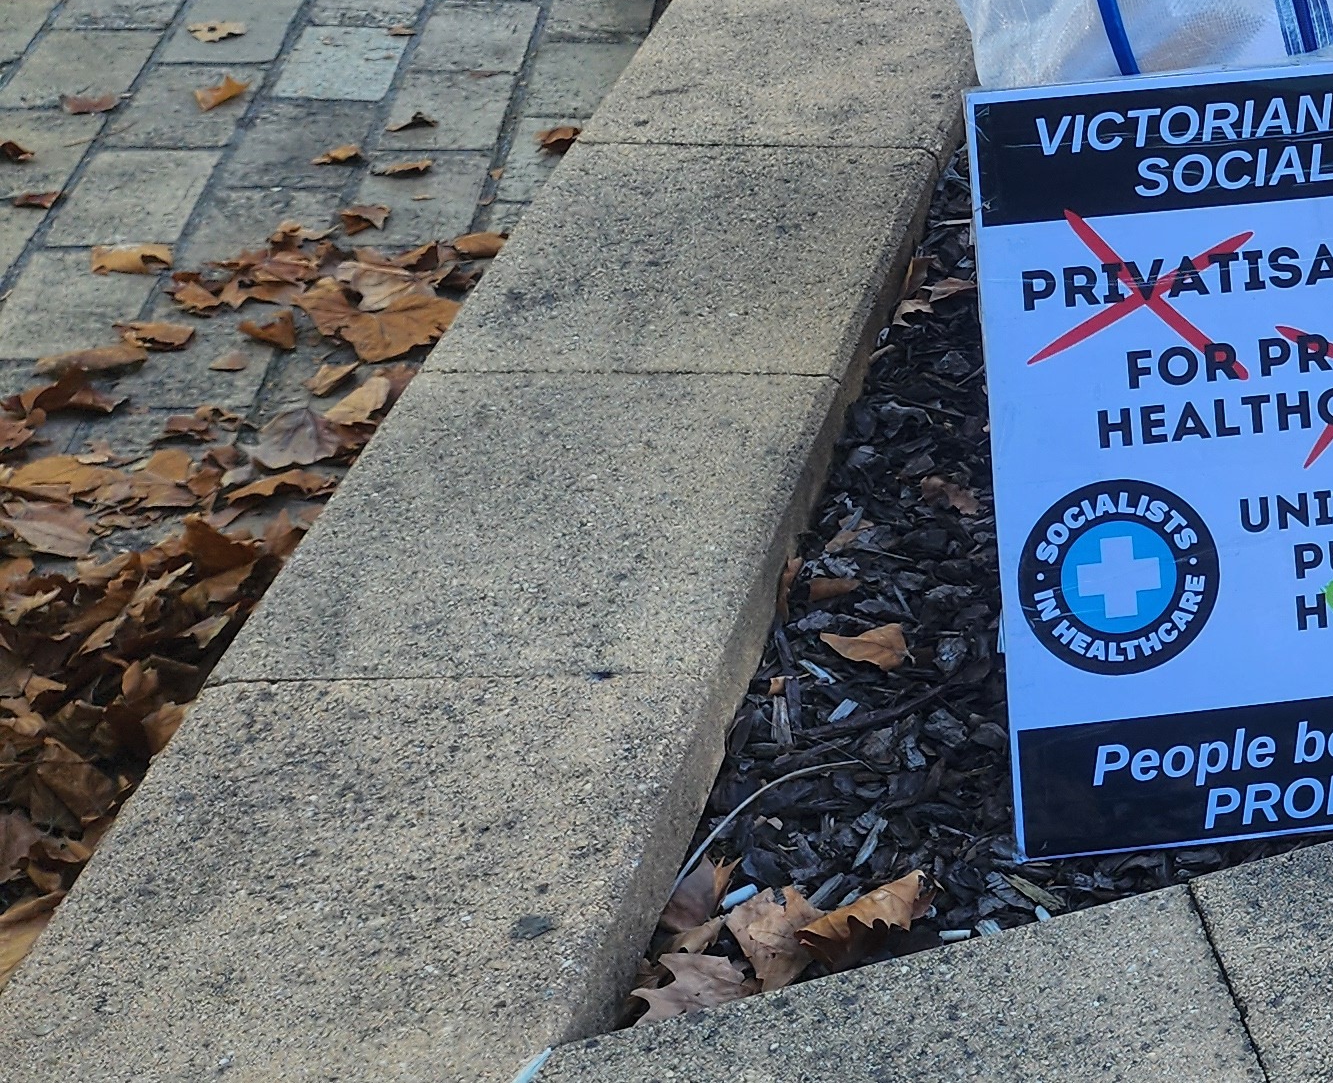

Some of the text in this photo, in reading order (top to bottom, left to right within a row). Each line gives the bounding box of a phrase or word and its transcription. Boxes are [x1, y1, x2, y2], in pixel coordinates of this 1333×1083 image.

[1036, 92, 1333, 157] VICTORIAN
[1126, 343, 1239, 390] FOR
[1035, 491, 1200, 567] SOCIALISTS
[1033, 572, 1207, 663] IN HEALTHCARE
[1093, 727, 1277, 787] People
